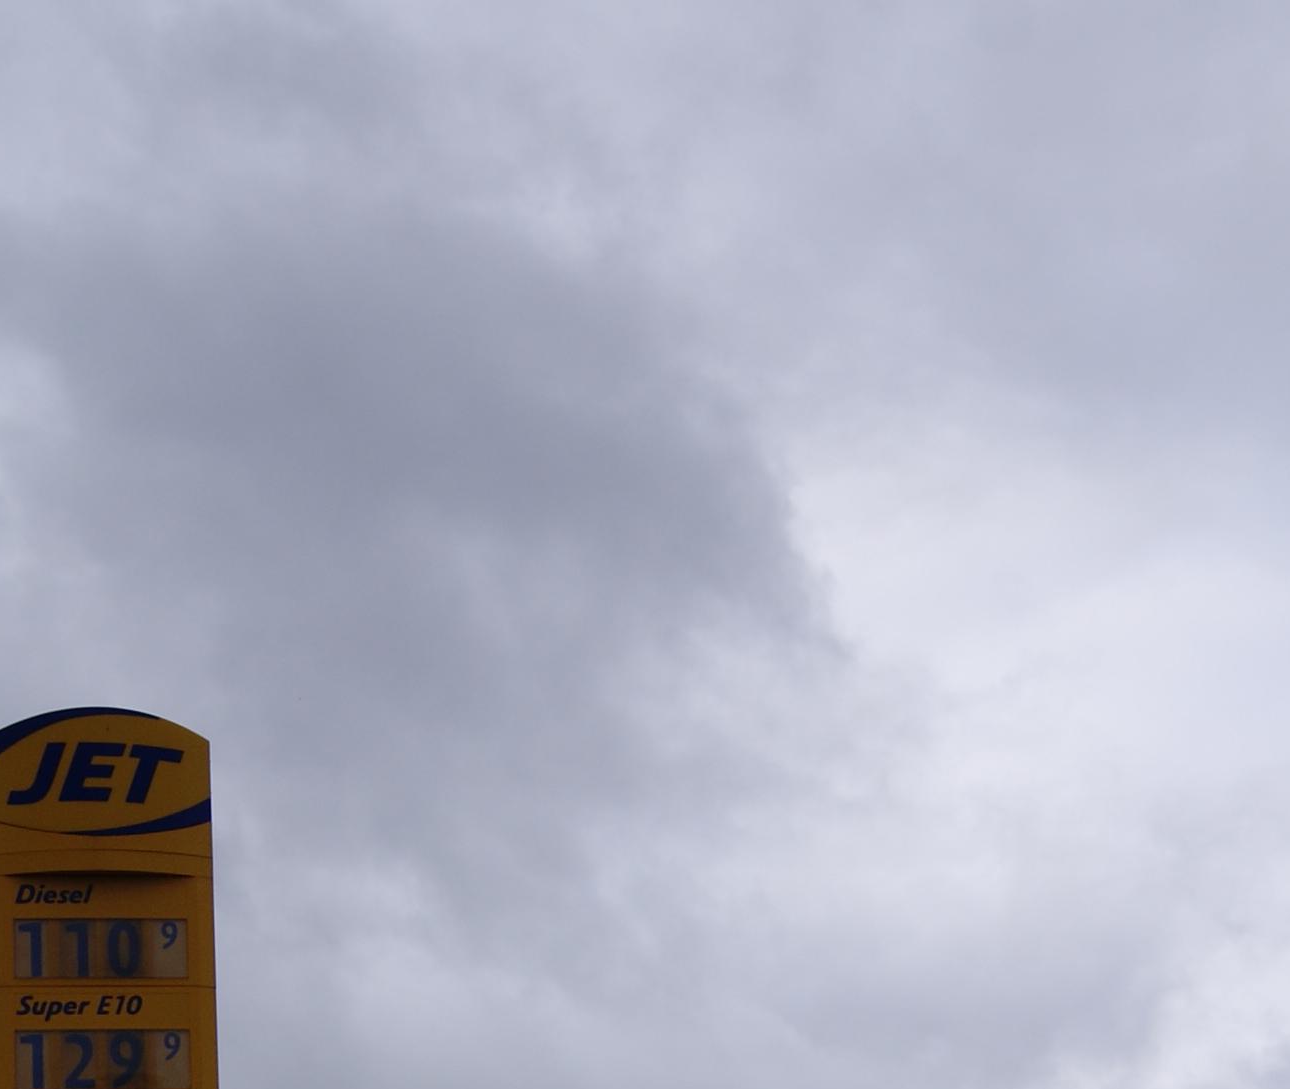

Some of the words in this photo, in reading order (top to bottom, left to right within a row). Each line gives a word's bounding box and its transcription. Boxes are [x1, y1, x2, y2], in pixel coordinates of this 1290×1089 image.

[8, 742, 183, 805] JET
[15, 884, 92, 905] Diesel
[16, 995, 90, 1019] Super
[97, 995, 142, 1015] E10
